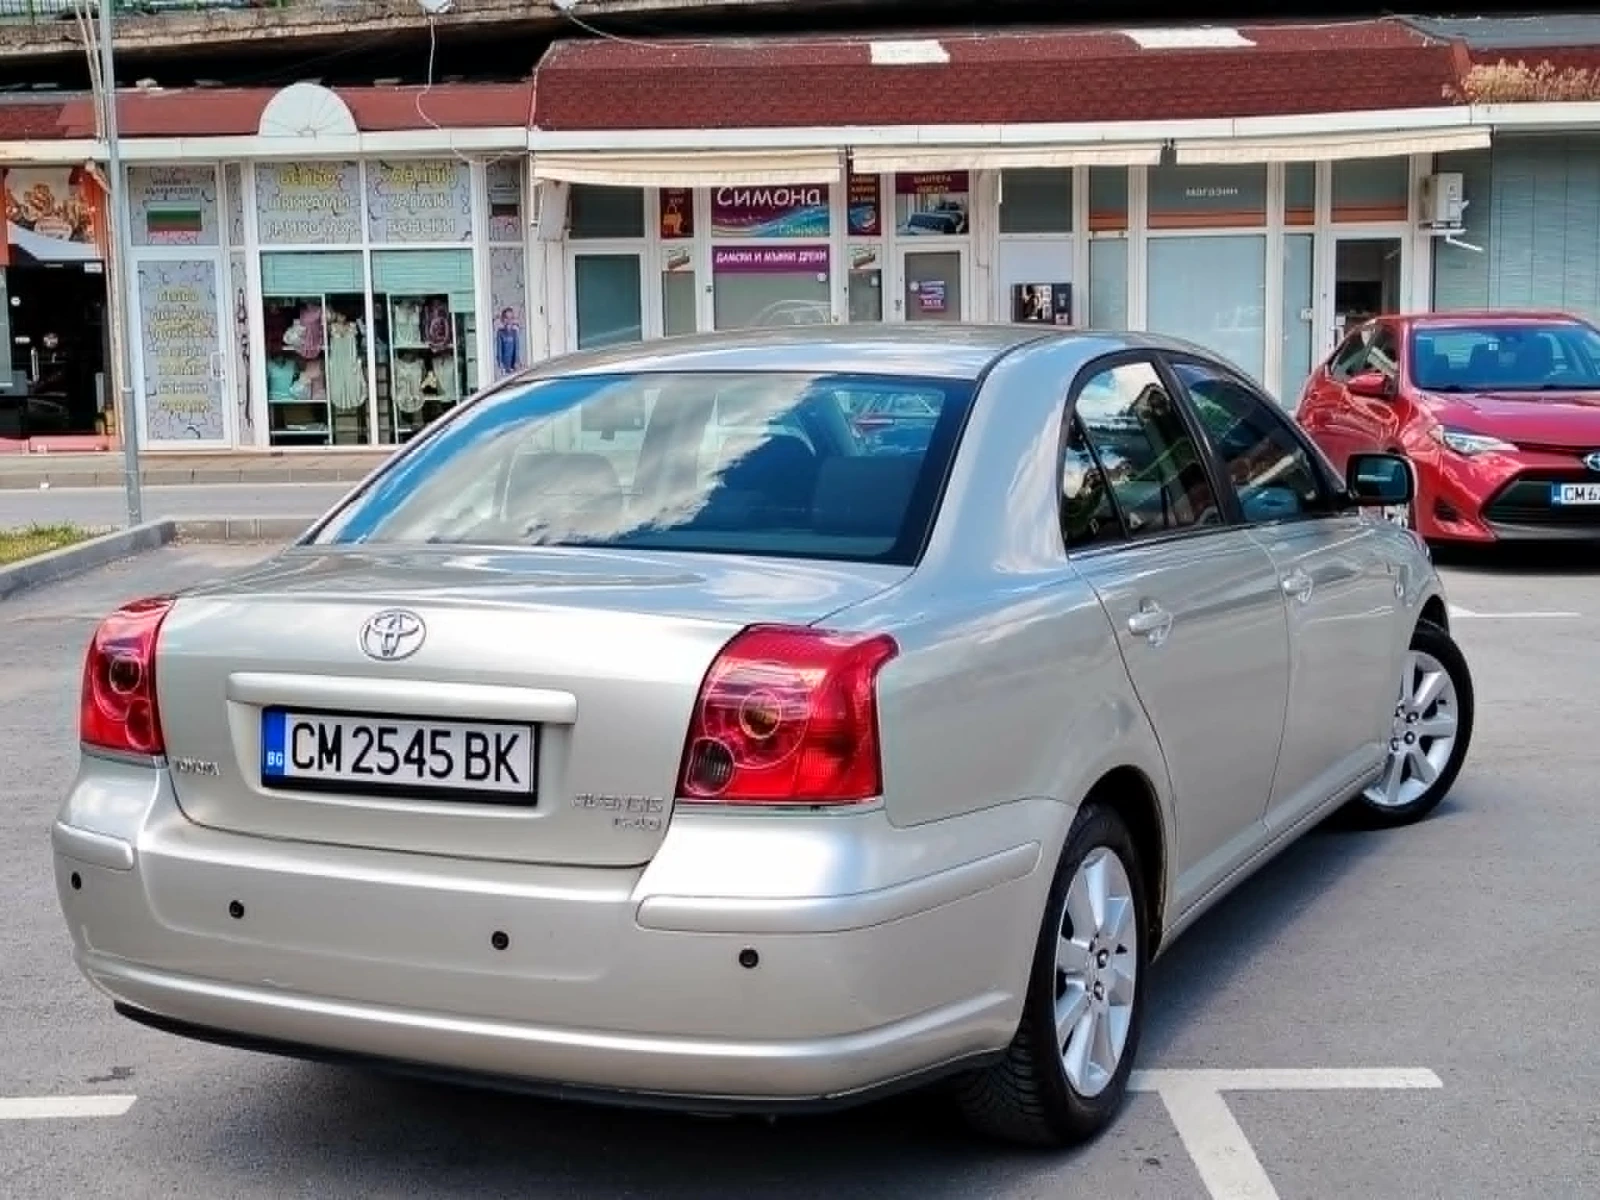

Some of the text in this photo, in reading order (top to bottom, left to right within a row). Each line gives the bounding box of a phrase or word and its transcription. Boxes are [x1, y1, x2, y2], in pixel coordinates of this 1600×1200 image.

[716, 186, 822, 208] Симона
[754, 251, 762, 263] И
[267, 751, 284, 766] BG
[291, 721, 520, 784] CM 2545 BK
